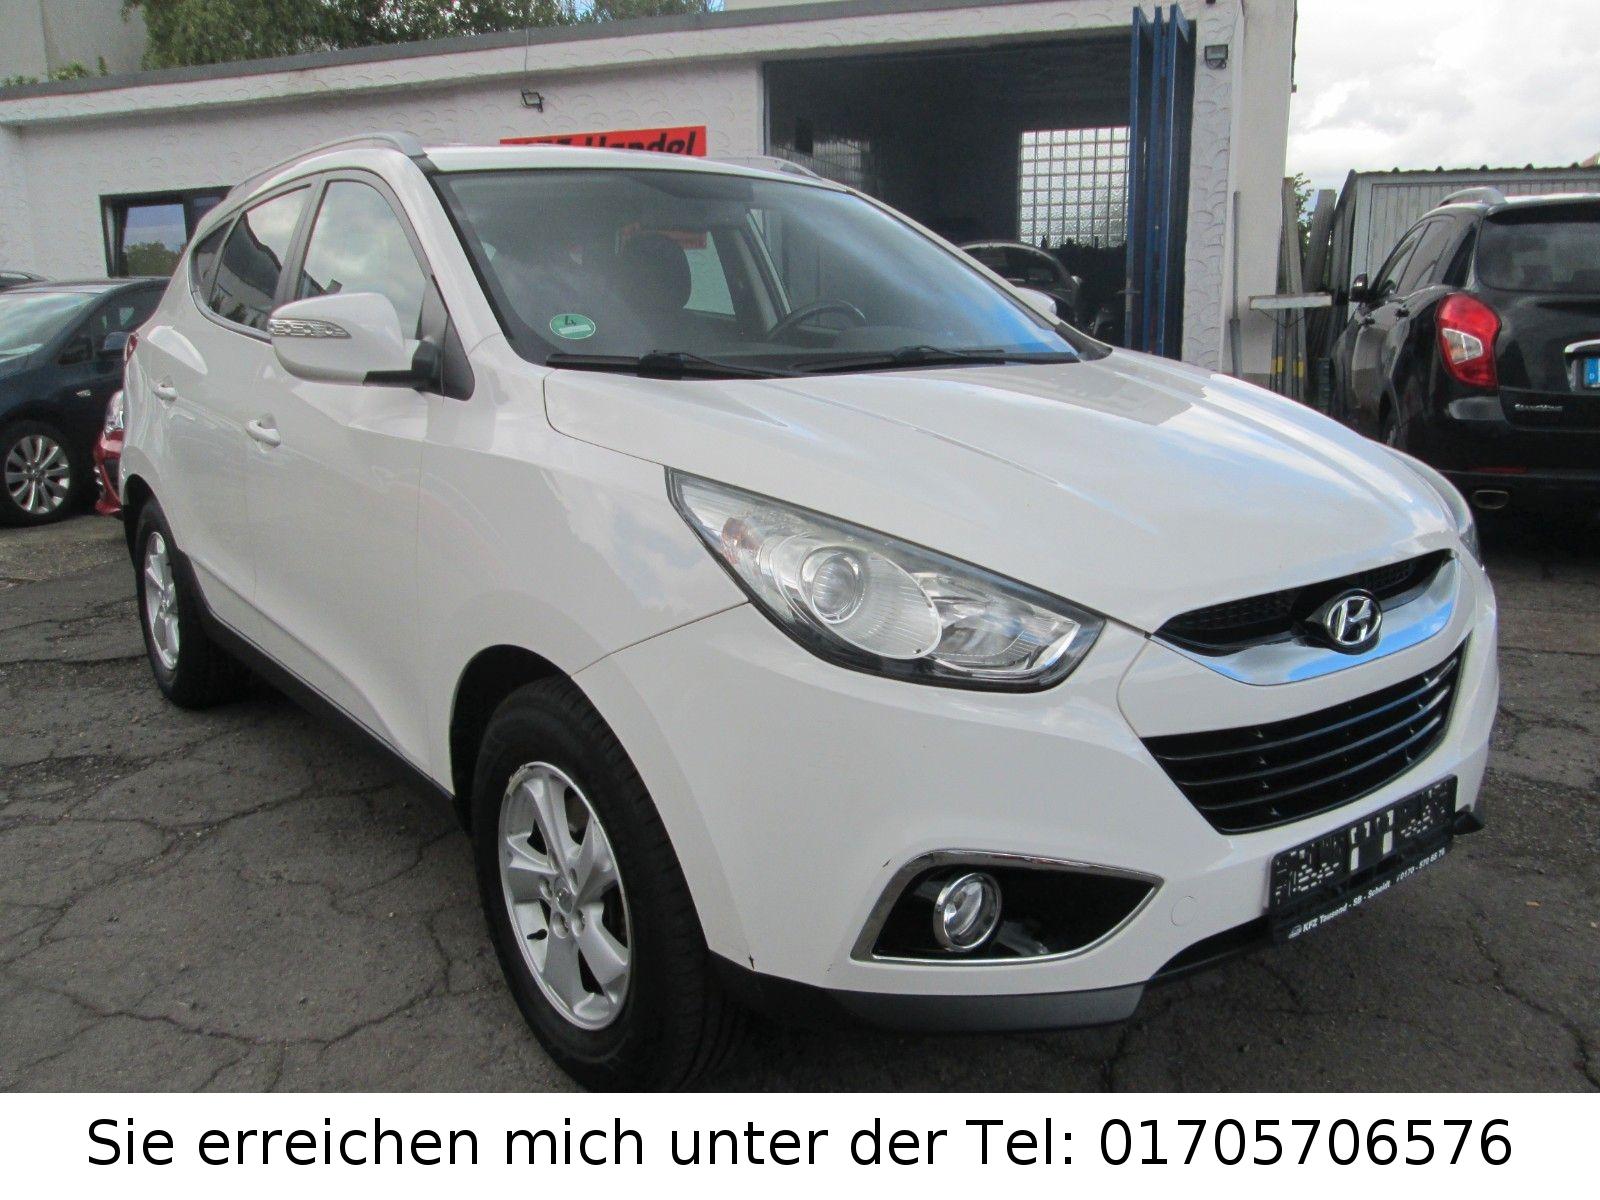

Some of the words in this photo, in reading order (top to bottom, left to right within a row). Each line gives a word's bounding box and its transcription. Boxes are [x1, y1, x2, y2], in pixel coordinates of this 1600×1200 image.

[585, 131, 696, 156] del
[1302, 918, 1318, 932] KFZ
[1320, 903, 1348, 923] Tausend
